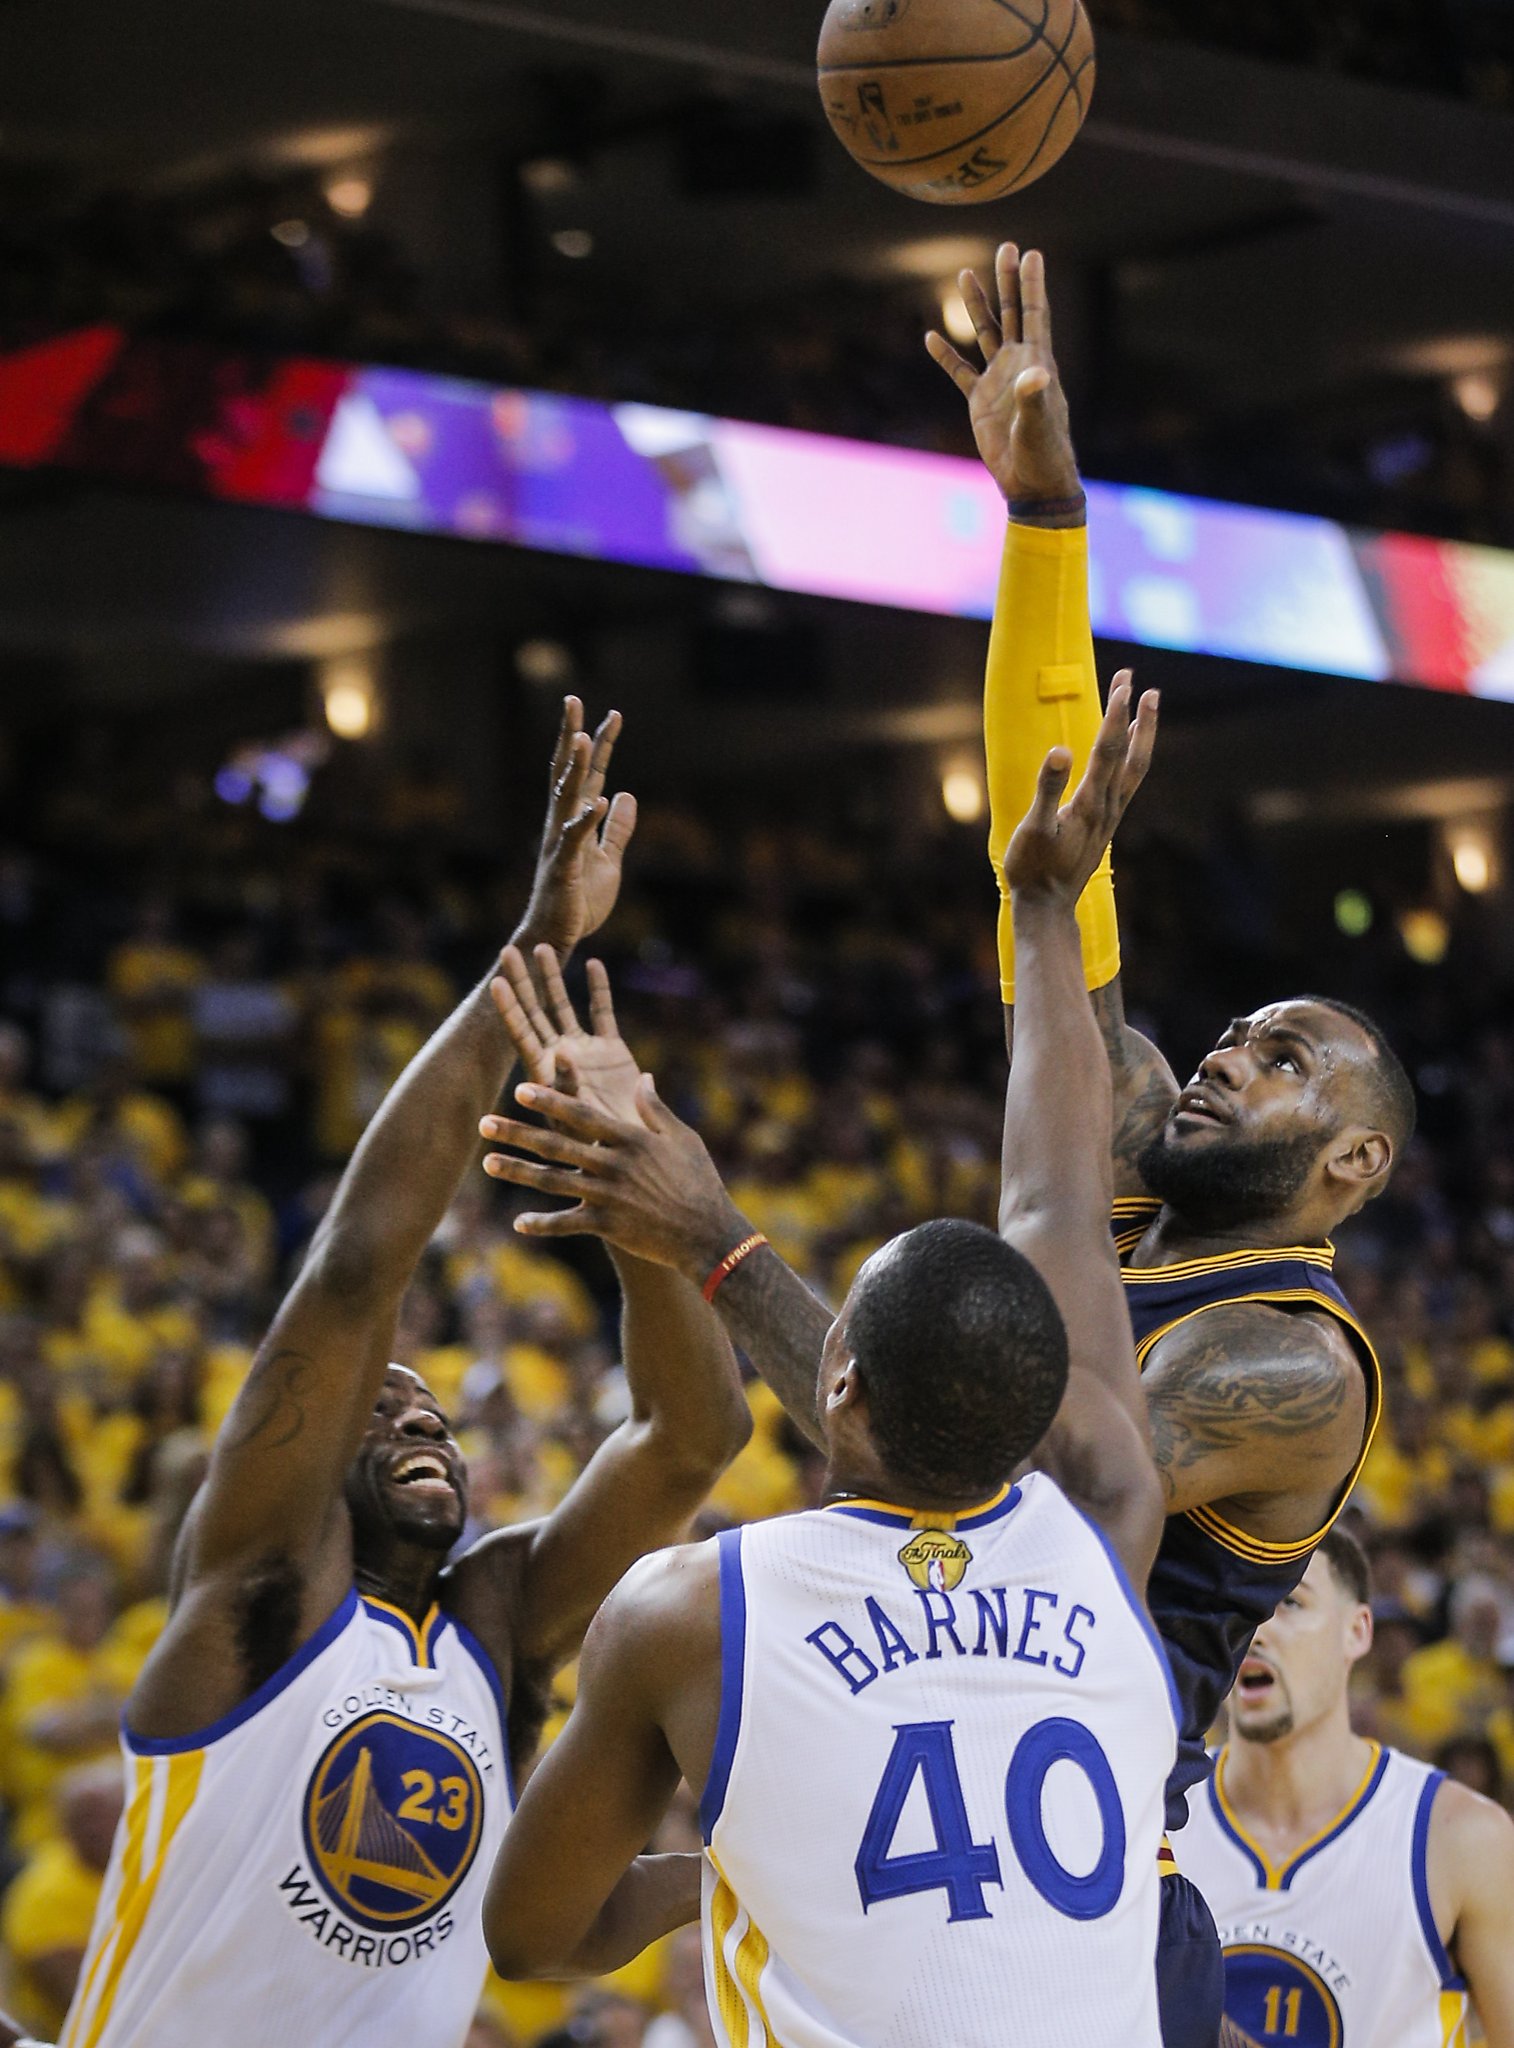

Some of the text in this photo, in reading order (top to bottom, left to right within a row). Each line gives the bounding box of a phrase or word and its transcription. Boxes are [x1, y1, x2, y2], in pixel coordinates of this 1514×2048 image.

[919, 1541, 967, 1564] Finals
[804, 1587, 1096, 1696] BARNES
[397, 1768, 470, 1832] 23
[854, 1716, 1127, 1924] 40
[279, 1865, 454, 1968] WARRIORS
[1285, 1931, 1351, 1993] STATE
[1264, 1984, 1303, 2037] 11
